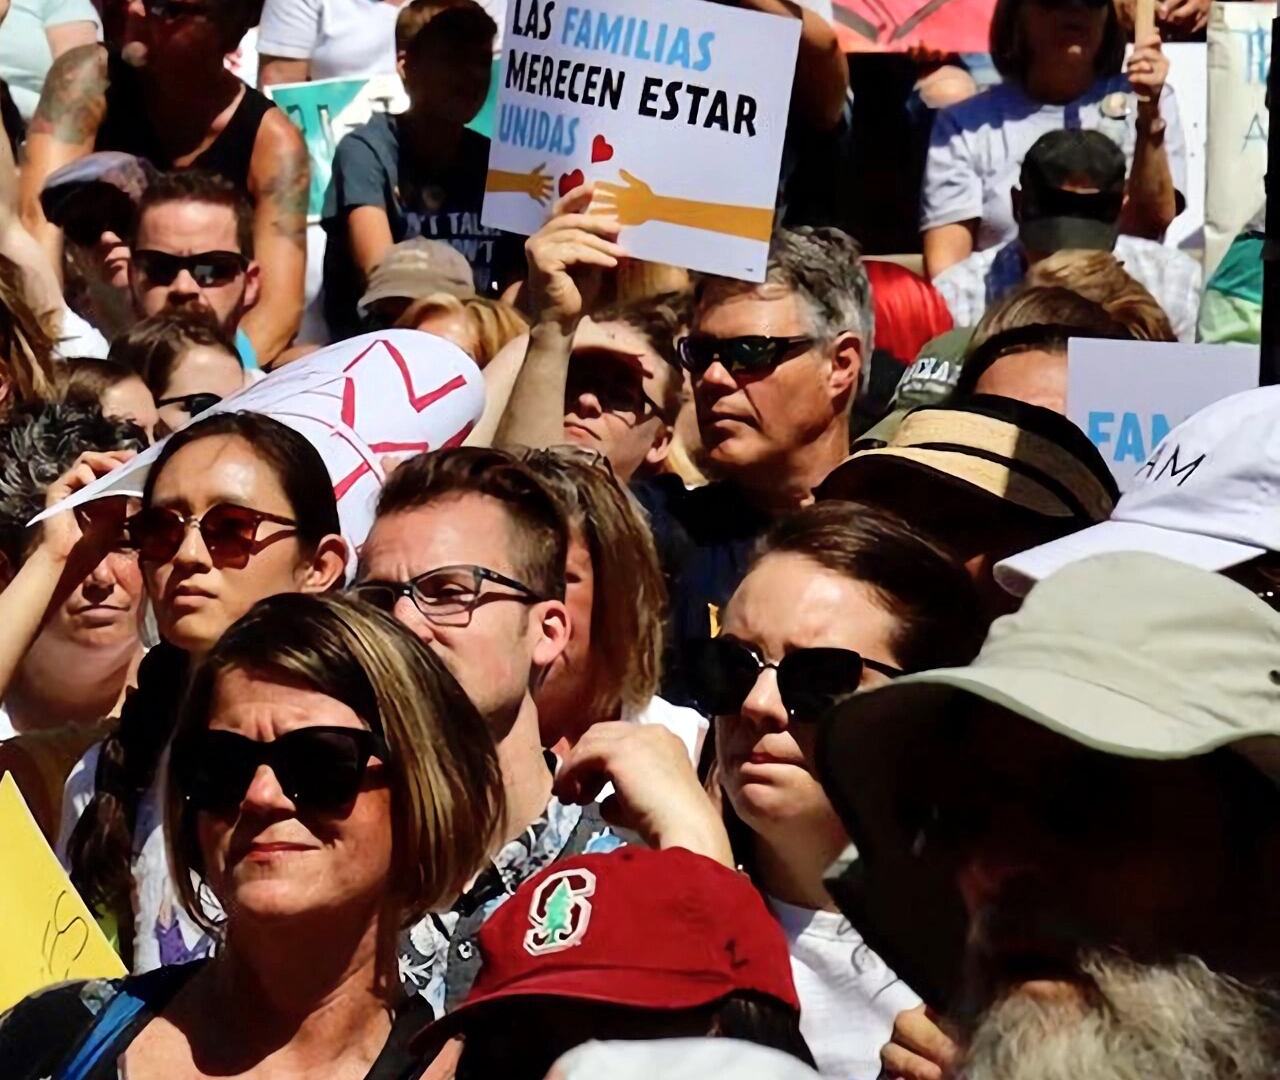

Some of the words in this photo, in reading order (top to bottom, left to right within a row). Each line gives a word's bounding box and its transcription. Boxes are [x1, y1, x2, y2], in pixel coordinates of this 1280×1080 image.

[560, 6, 716, 72] FAMILIAS
[504, 49, 626, 111] MERECEN
[638, 75, 758, 138] ESTAR
[498, 103, 581, 157] UNIDAS
